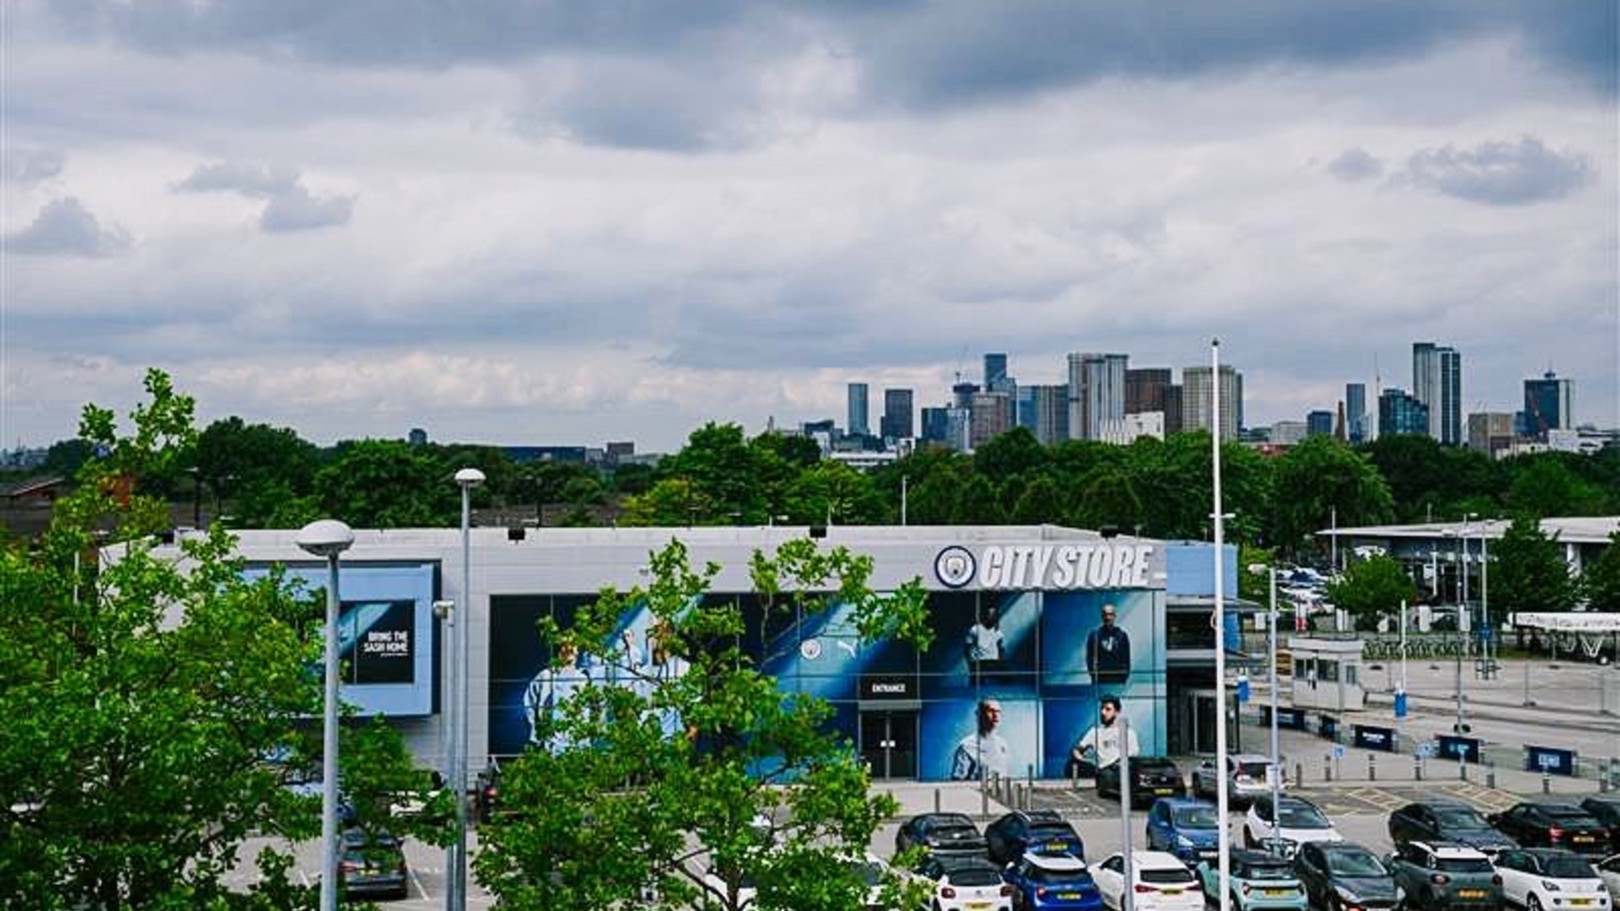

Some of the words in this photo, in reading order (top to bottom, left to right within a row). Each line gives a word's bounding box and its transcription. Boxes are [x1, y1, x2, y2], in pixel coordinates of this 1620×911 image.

[979, 545, 1054, 588] CITY
[1053, 545, 1154, 588] STORE
[368, 631, 391, 641] BRING
[393, 631, 408, 642] THE
[387, 643, 408, 652] HOME
[872, 683, 906, 693] ENTRANCE
